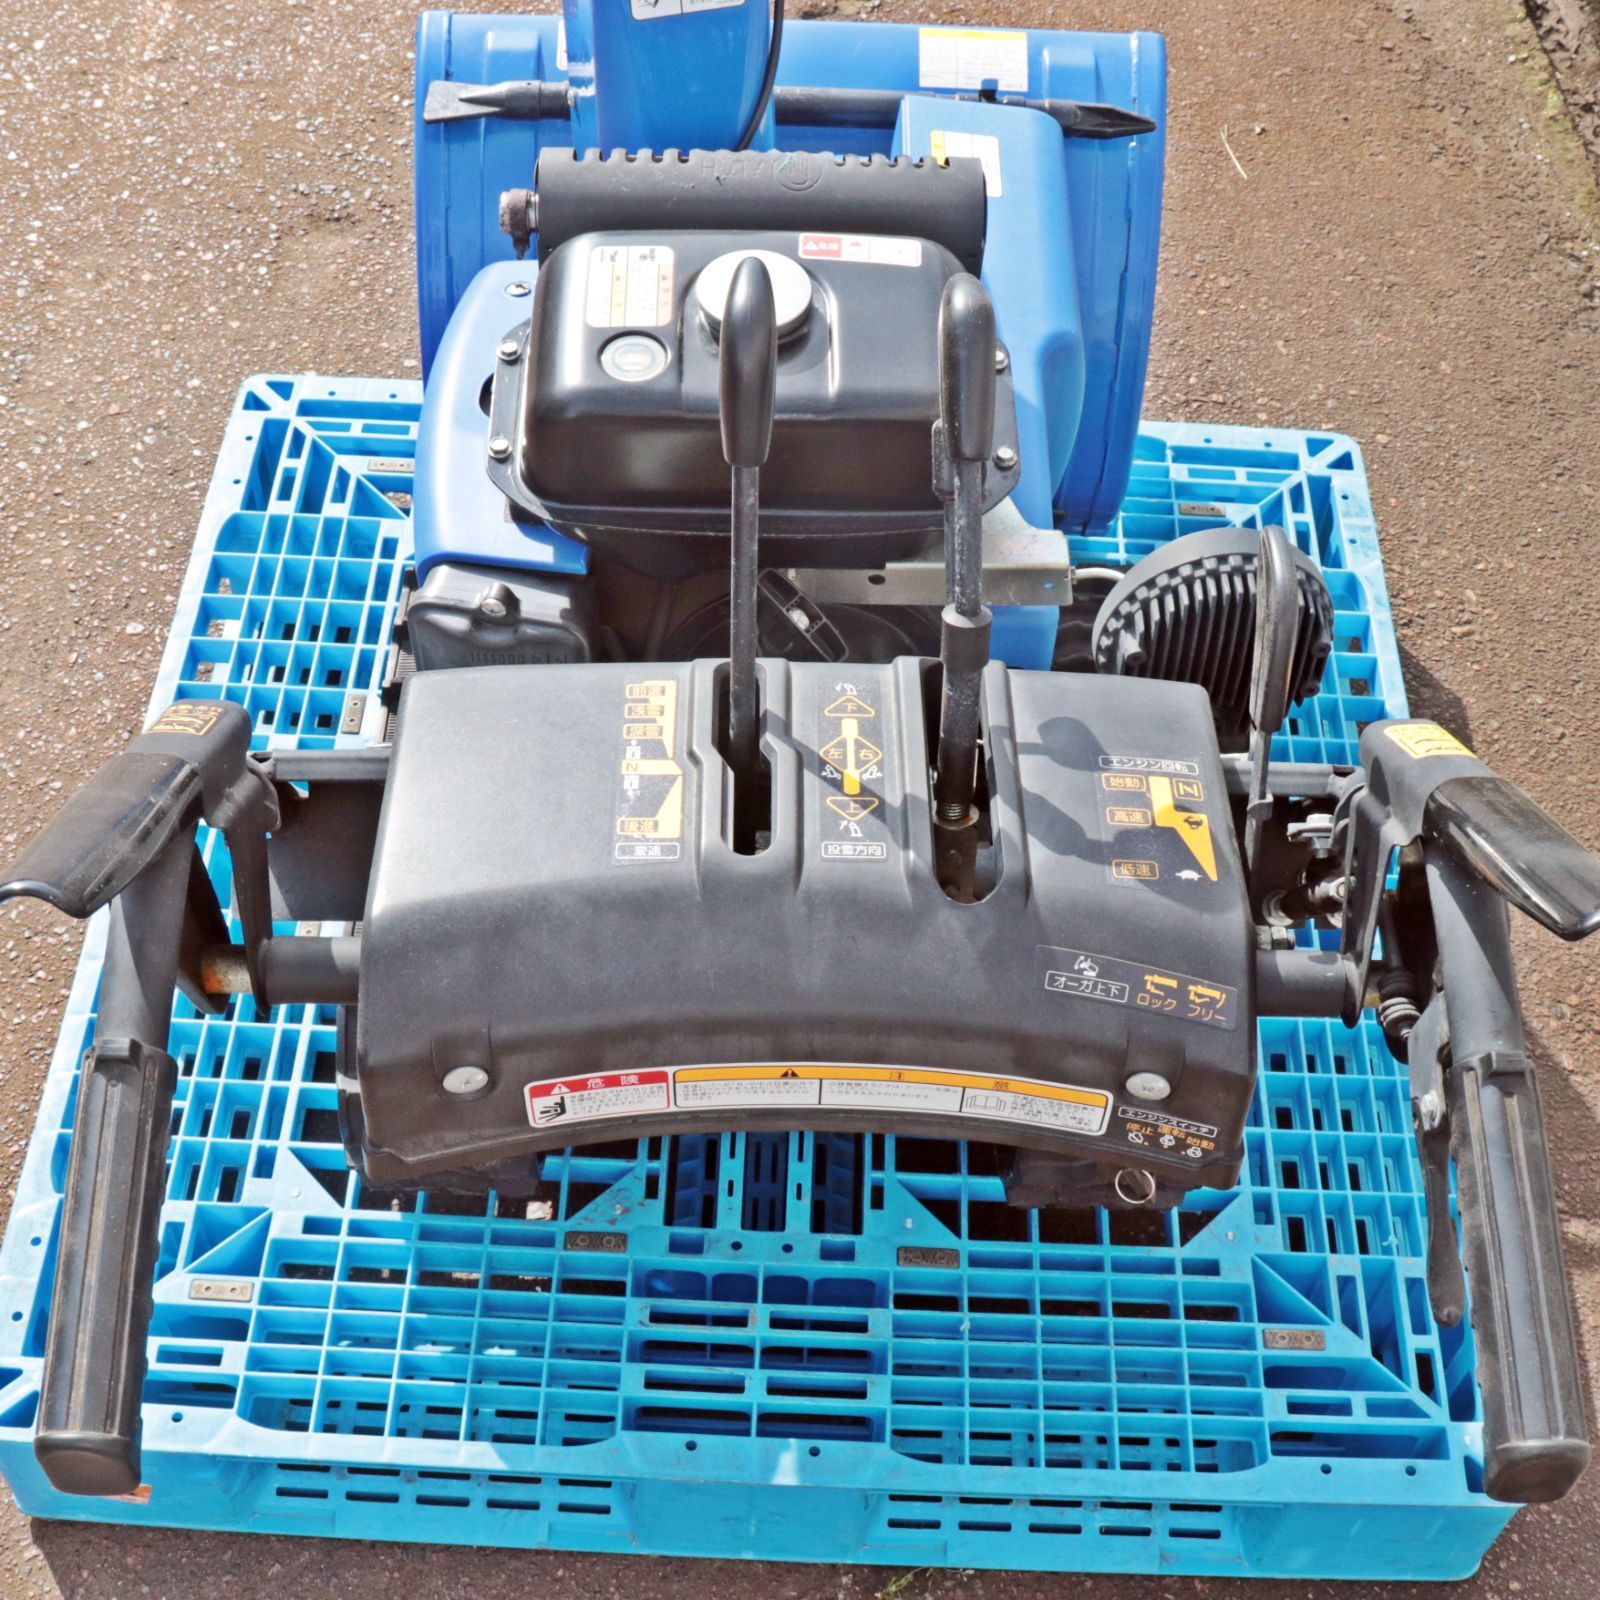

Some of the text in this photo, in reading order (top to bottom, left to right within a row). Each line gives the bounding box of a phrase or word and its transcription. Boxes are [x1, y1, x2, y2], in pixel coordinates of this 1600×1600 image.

[844, 701, 859, 713] 下
[828, 746, 844, 760] 左
[858, 747, 874, 760] 右
[625, 762, 639, 772] N
[1109, 757, 1189, 772] エンジン回転
[1109, 776, 1141, 788] 始動
[845, 800, 861, 813] 上
[1114, 810, 1145, 823] 高速
[826, 844, 883, 857] 投雪方向
[1119, 862, 1152, 877] 低速
[1053, 975, 1122, 998] オーガ上下
[1136, 992, 1228, 1022] ロック フリー
[1125, 1109, 1210, 1134] エンジンスイッチ
[1126, 1122, 1215, 1151] 停止 運転 始動
